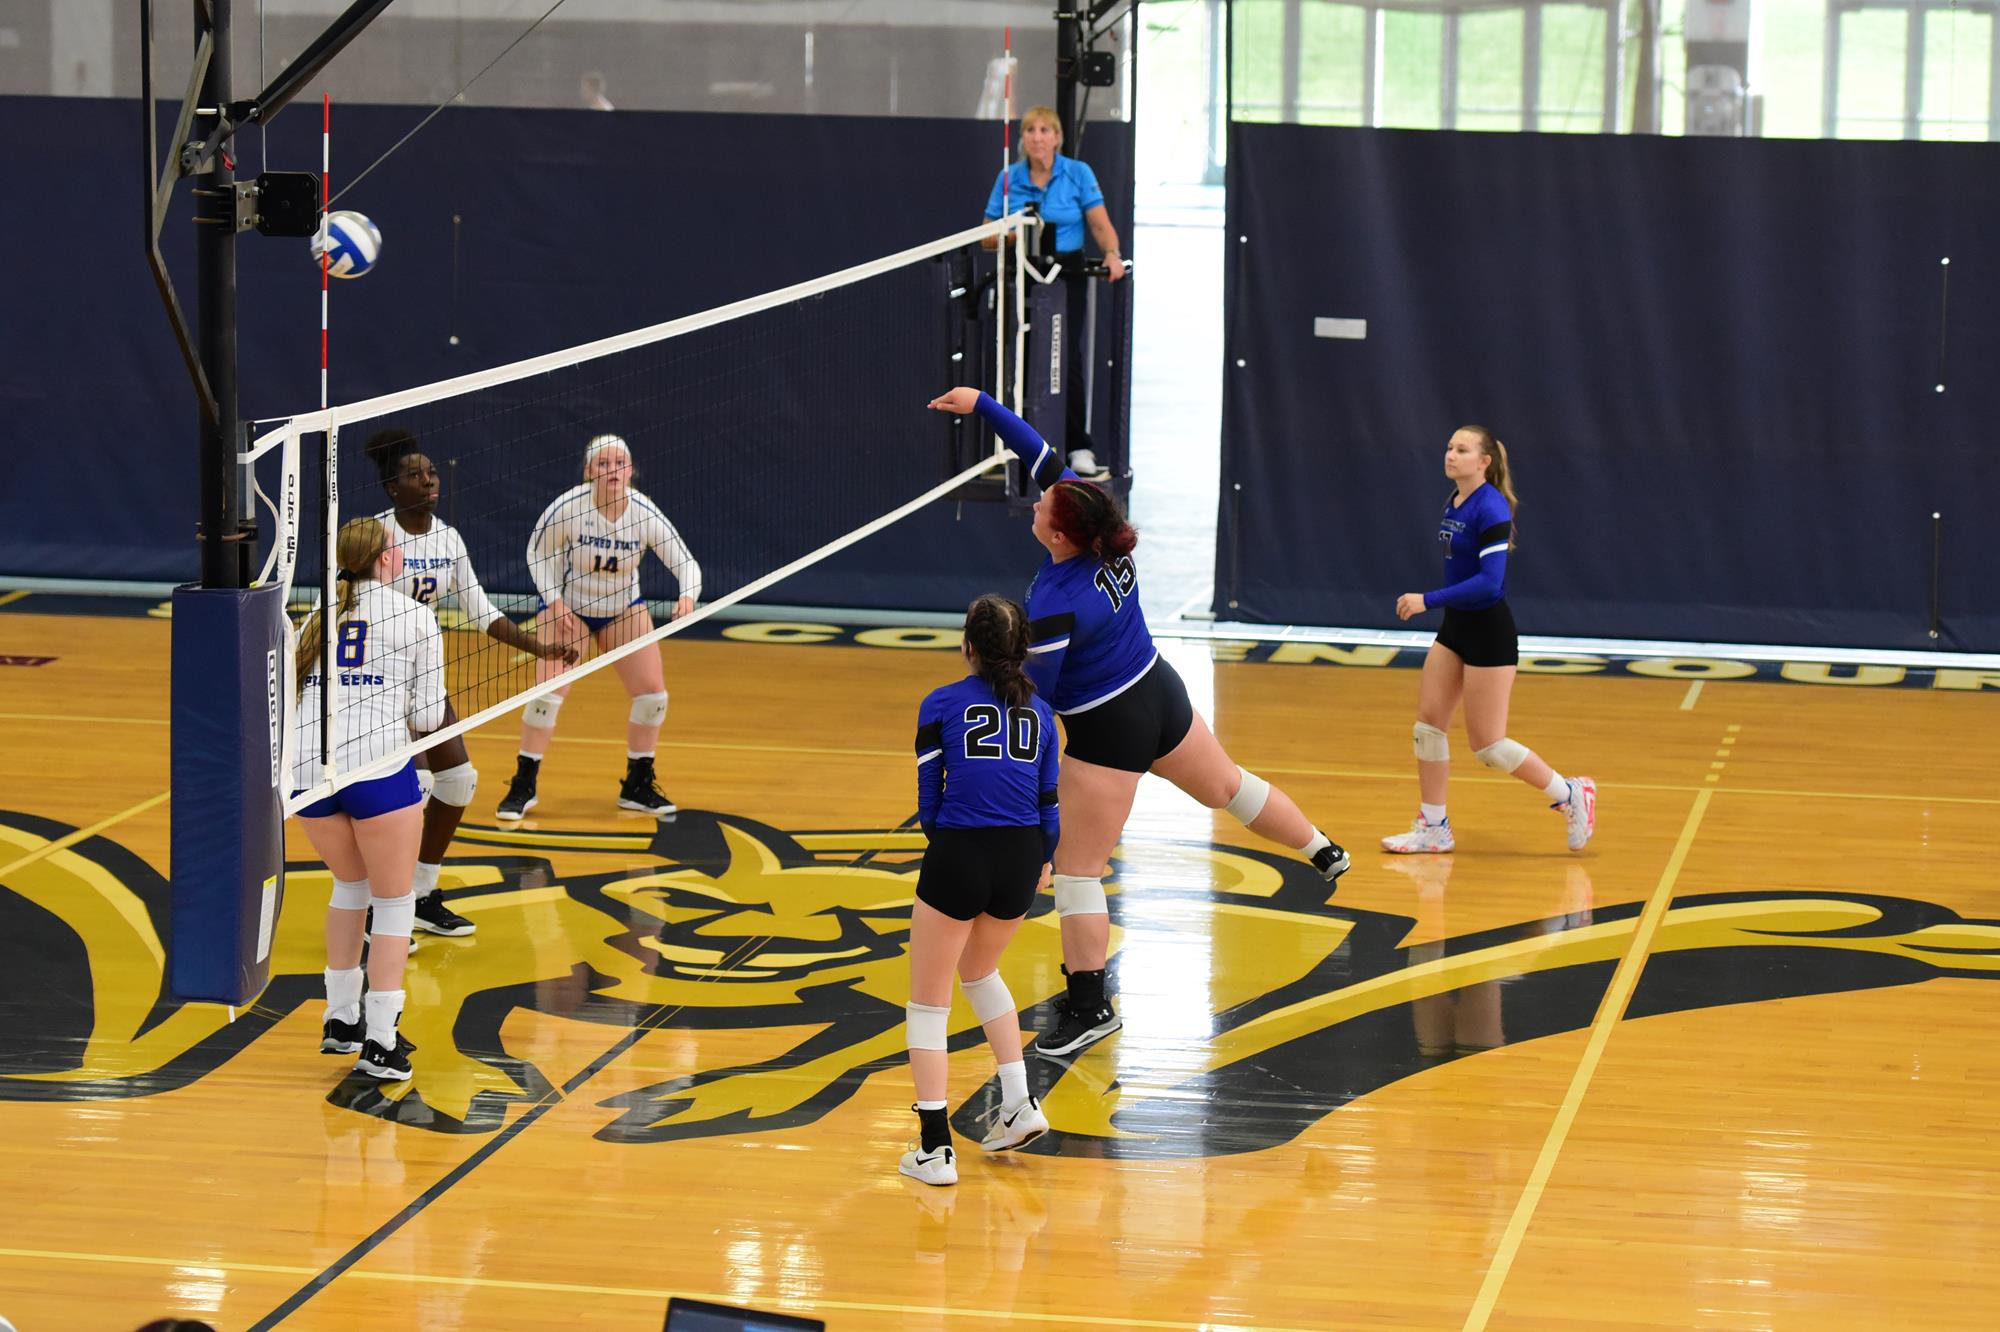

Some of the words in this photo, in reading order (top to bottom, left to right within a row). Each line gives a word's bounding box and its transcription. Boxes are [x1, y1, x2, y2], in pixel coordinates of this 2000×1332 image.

[577, 534, 612, 549] ALFRED
[403, 558, 426, 570] FRED
[593, 555, 618, 573] 14
[411, 577, 438, 604] 12
[1094, 556, 1137, 613] 15
[337, 619, 368, 668] 8
[304, 674, 385, 687] PIEERS
[268, 653, 279, 784] PORTER
[964, 703, 1041, 763] 20
